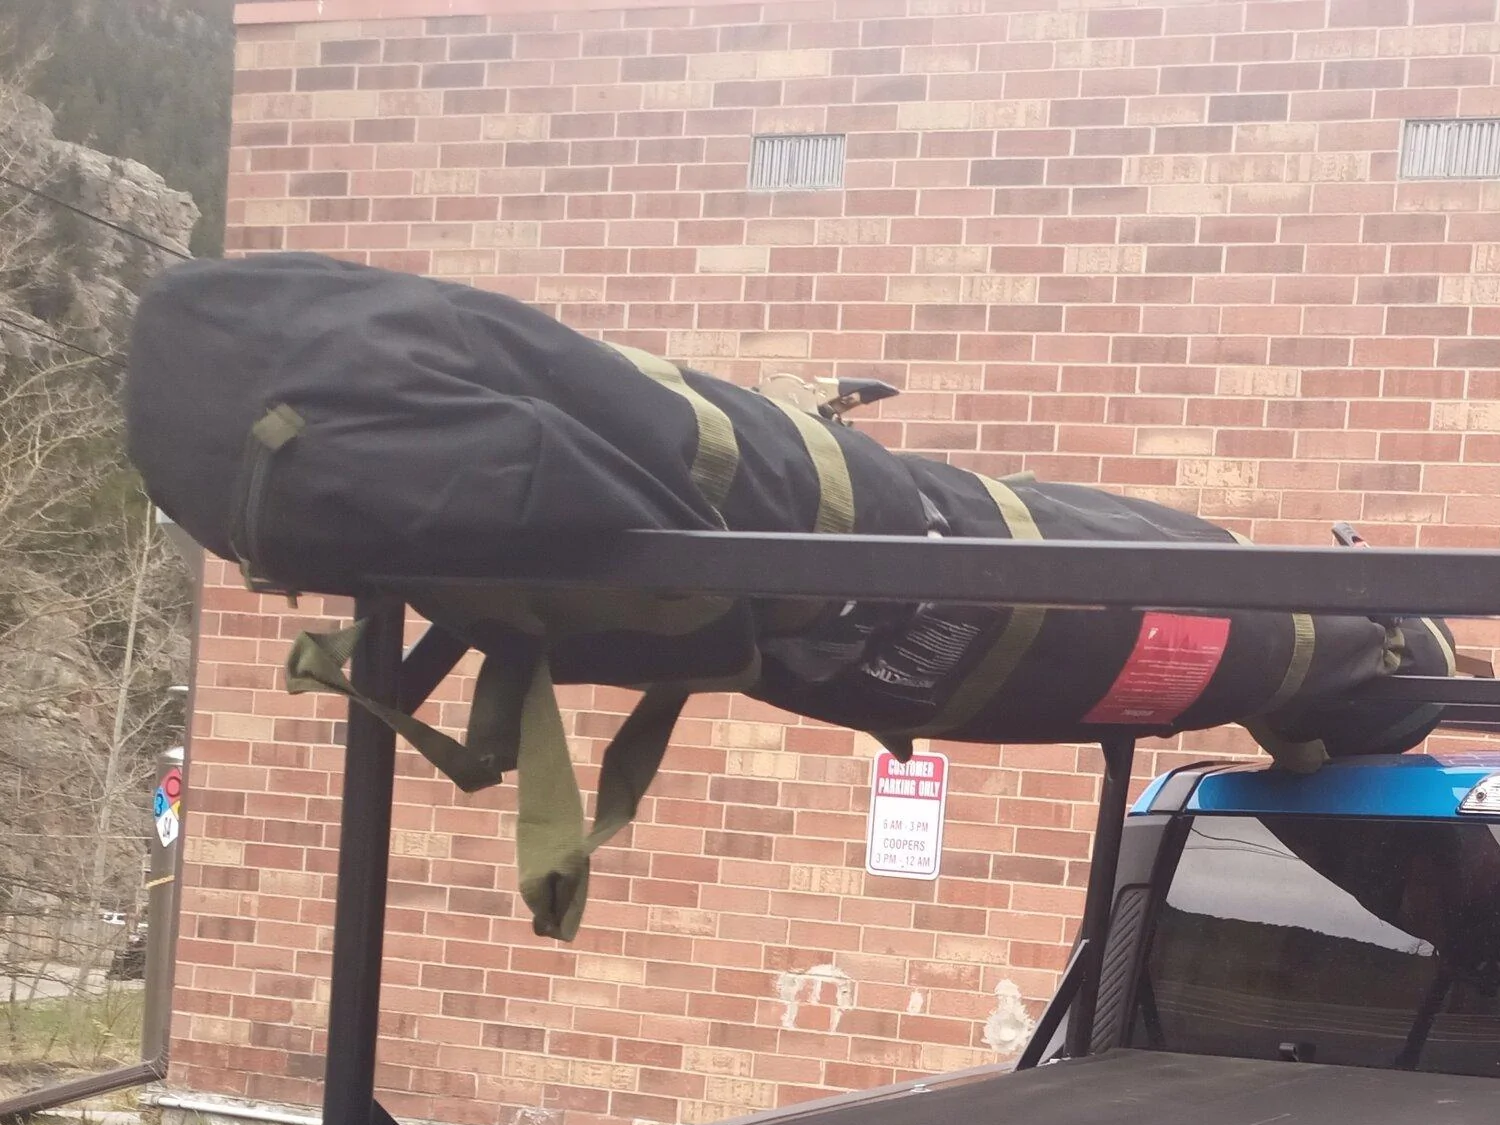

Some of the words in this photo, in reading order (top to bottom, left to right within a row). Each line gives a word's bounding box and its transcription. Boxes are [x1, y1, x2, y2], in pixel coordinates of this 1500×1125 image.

[887, 759, 934, 777] CUSTOMER
[878, 777, 916, 796] PARKING
[918, 780, 940, 797] ONLY
[889, 820, 902, 830] AM
[909, 821, 915, 832] 3
[916, 822, 929, 833] PM
[883, 838, 926, 852] COOPERS
[876, 853, 881, 864] 3
[883, 853, 897, 865] PM
[905, 855, 915, 866] 12
[917, 857, 931, 867] AM
